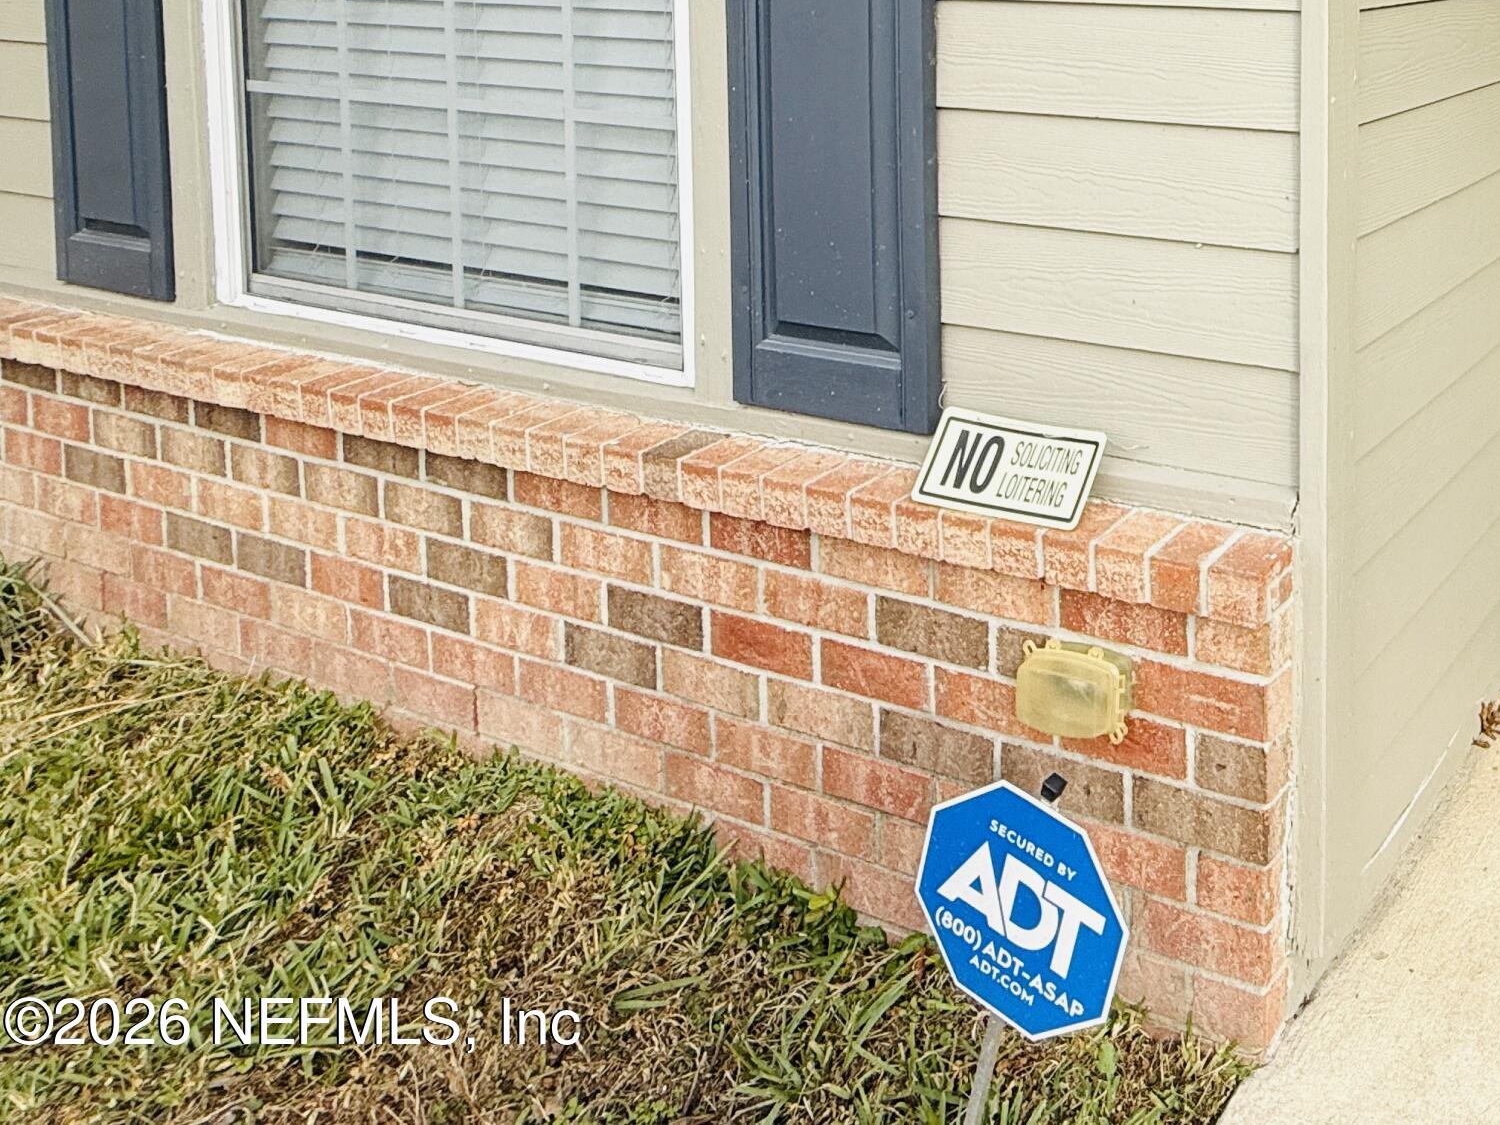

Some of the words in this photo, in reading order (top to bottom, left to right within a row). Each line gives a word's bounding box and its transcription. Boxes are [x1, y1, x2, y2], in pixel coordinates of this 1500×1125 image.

[940, 429, 1005, 494] NO
[1010, 441, 1083, 475] SOLICITING
[996, 472, 1067, 508] LOITERING
[989, 819, 1054, 867] SECURED
[1057, 862, 1076, 881] BY
[936, 840, 1106, 980] ADT
[935, 906, 982, 950] (800)
[982, 941, 1084, 1017] ADT-ASAP
[969, 955, 1035, 1006] ADT.COM
